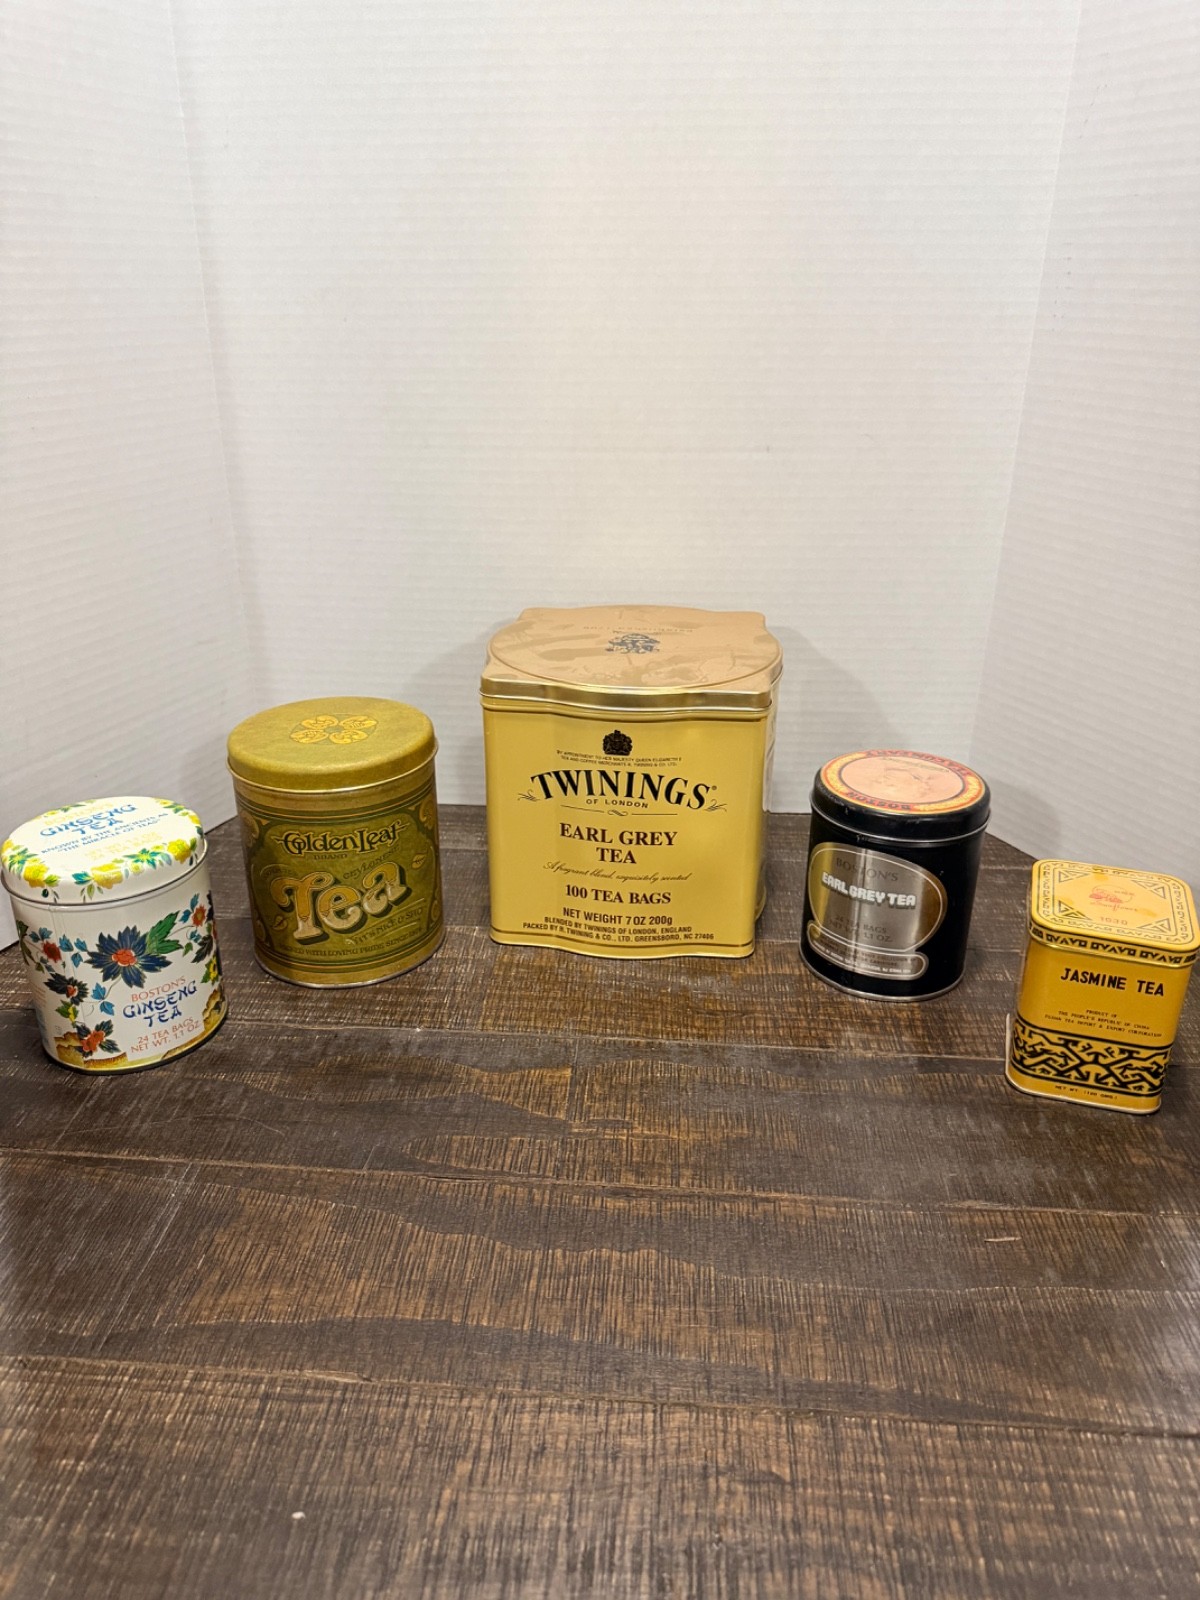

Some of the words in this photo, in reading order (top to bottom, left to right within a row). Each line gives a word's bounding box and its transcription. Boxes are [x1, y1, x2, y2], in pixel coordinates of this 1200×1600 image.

[530, 769, 711, 810] TWININGS
[605, 799, 648, 808] LONDON
[40, 804, 137, 836] GINSENG
[72, 818, 124, 834] TEA
[41, 840, 79, 854] KNOWN
[94, 830, 111, 838] THE
[82, 832, 120, 845] MIRACLE
[560, 822, 613, 844] EARL
[619, 830, 678, 846] GREY
[596, 847, 637, 864] TEA
[269, 861, 409, 943] Tea
[566, 884, 588, 899] 100
[592, 888, 624, 903] TEA
[629, 892, 672, 904] BAGS
[822, 872, 848, 895] EARL
[848, 885, 886, 904] GREY
[887, 893, 916, 908] TEA
[544, 916, 572, 926] BLENDED
[584, 924, 616, 934] TWININGS
[661, 926, 692, 934] ENGLAND
[563, 907, 580, 918] NET
[584, 911, 623, 924] WEIGHT
[626, 916, 632, 925] 7
[633, 916, 646, 926] OZ
[649, 916, 672, 926] 200g
[523, 922, 548, 930] PACKED
[550, 924, 558, 932] BY
[567, 928, 594, 938] TWINING
[132, 976, 186, 1002] BOSTON'S
[1060, 968, 1127, 990] JASMINE
[1136, 980, 1164, 996] TEA
[123, 980, 197, 1018] GINSENG
[144, 1005, 182, 1028] TEA
[1086, 1009, 1108, 1018] PRODUCT
[130, 1043, 148, 1053] NET
[152, 1036, 171, 1047] WT.
[187, 1020, 200, 1032] OZ
[138, 1036, 148, 1044] 24
[152, 1030, 170, 1040] TEA
[172, 1016, 194, 1032] BAGS
